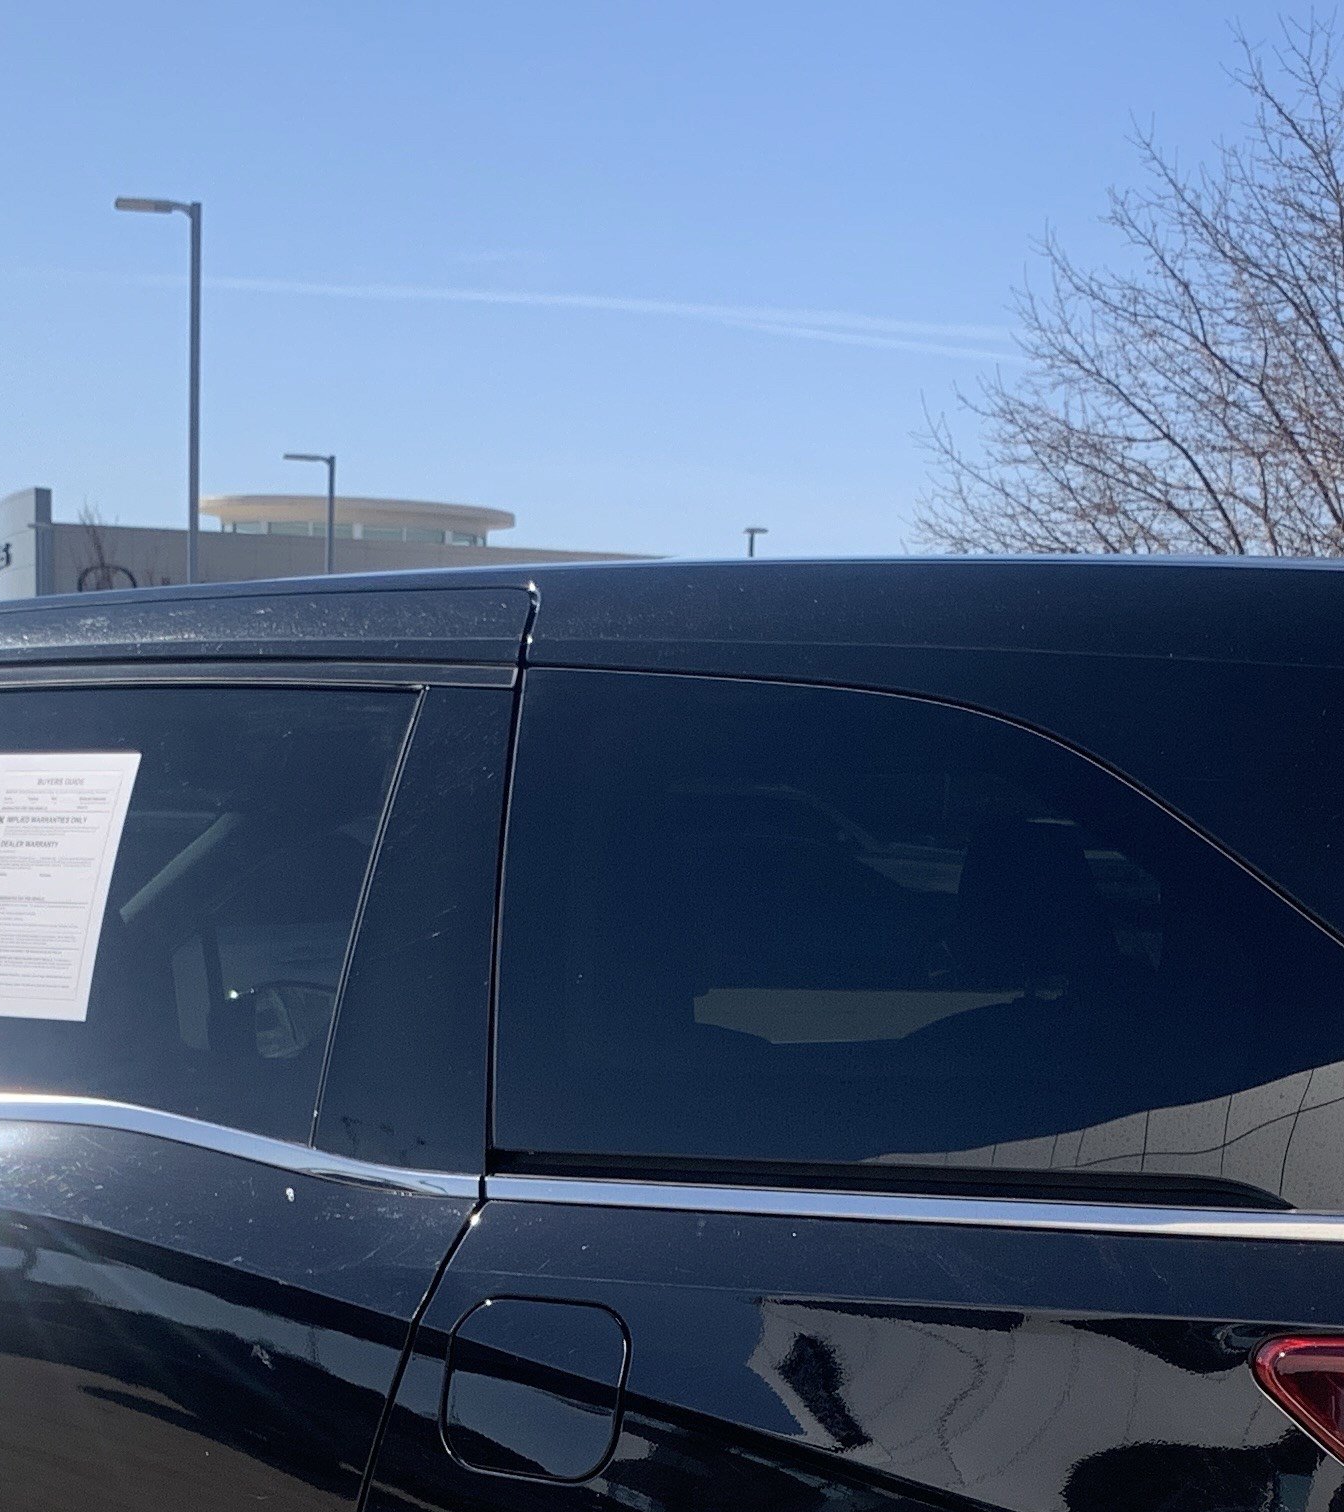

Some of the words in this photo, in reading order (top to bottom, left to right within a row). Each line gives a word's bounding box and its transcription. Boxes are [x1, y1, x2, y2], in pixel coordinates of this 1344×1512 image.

[37, 777, 63, 786] BUYERS
[64, 777, 86, 786] GUIDE
[7, 815, 30, 824] IMPLIED
[31, 815, 70, 824] WARRANTIES
[71, 815, 88, 824] ONLY
[0, 840, 24, 848] DEALER
[25, 840, 59, 848] WARRANTY
